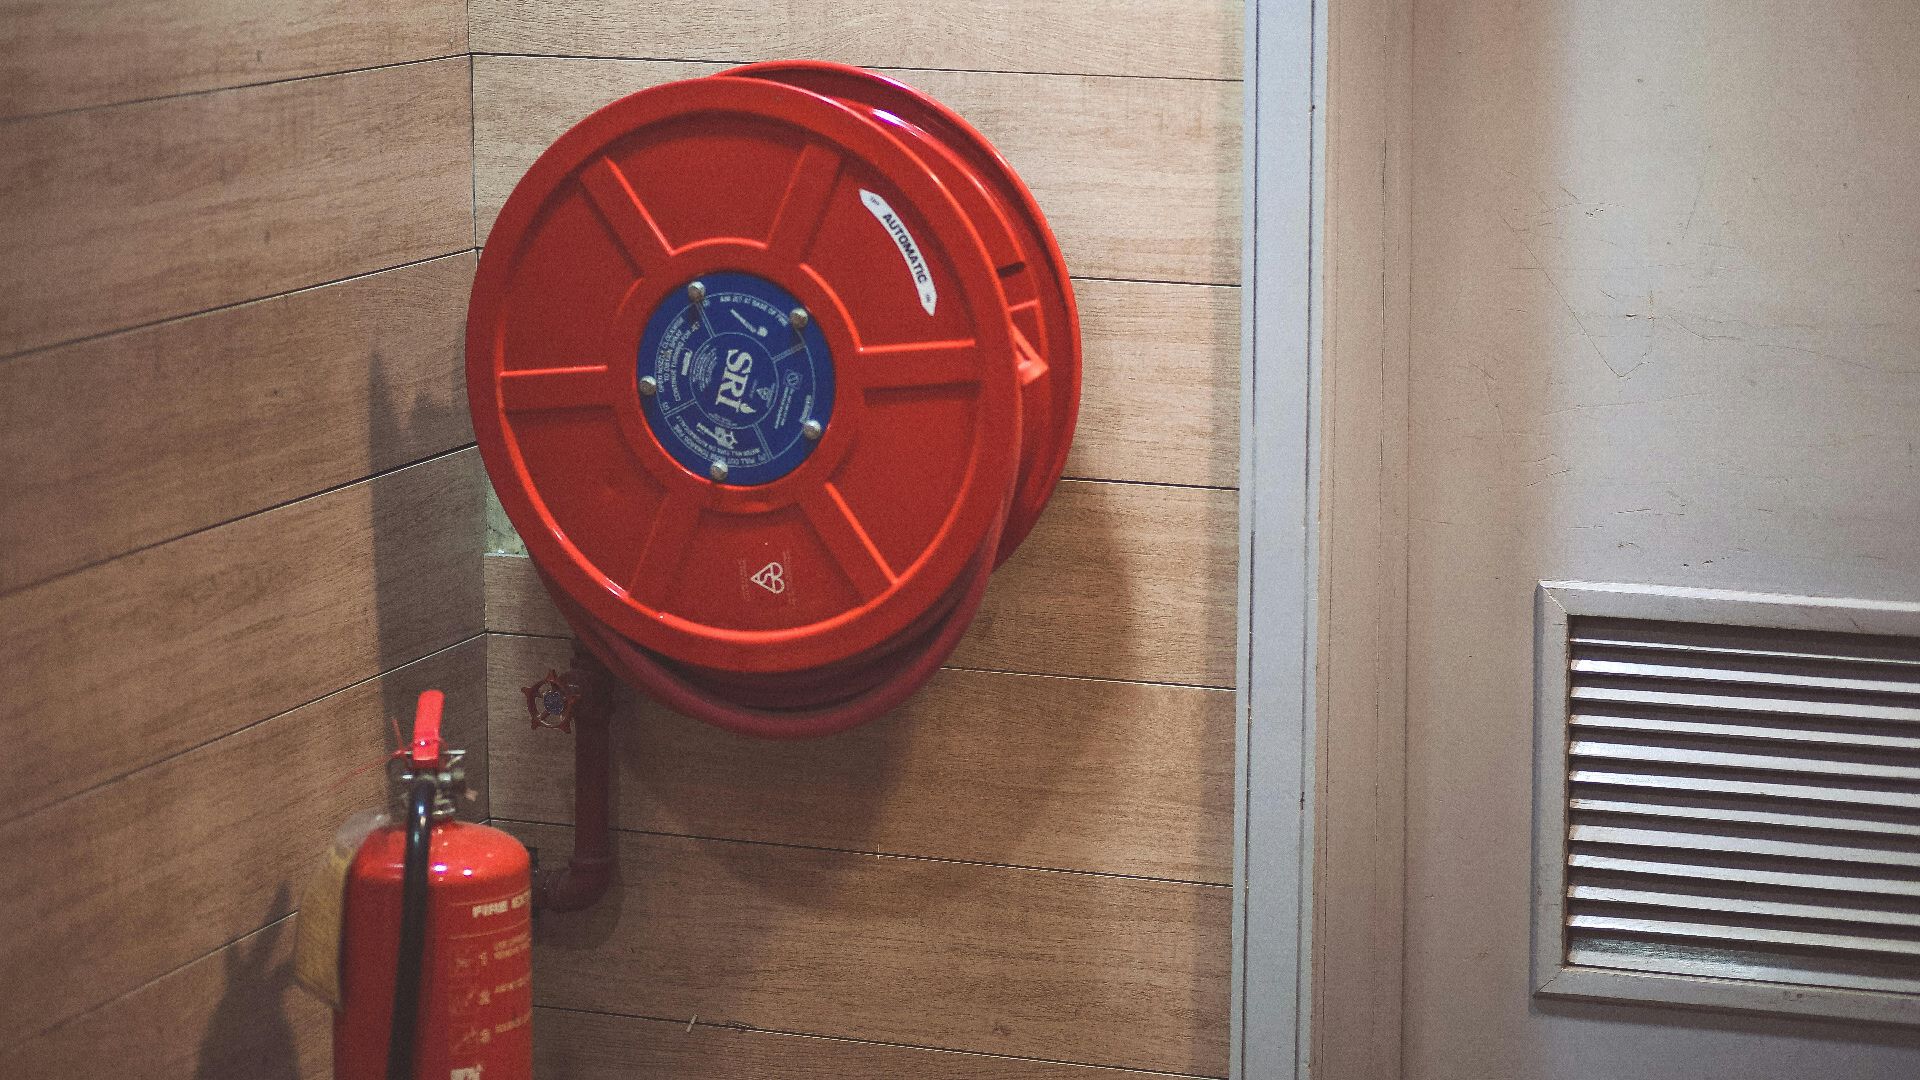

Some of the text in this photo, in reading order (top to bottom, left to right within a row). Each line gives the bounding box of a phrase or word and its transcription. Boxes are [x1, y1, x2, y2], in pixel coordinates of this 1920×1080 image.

[882, 213, 928, 284] AUTOMATIC
[656, 374, 664, 393] OPEN
[663, 372, 669, 381] TO
[669, 368, 681, 403] CONTINUE
[715, 349, 756, 414] SRI
[471, 900, 508, 919] FIRE
